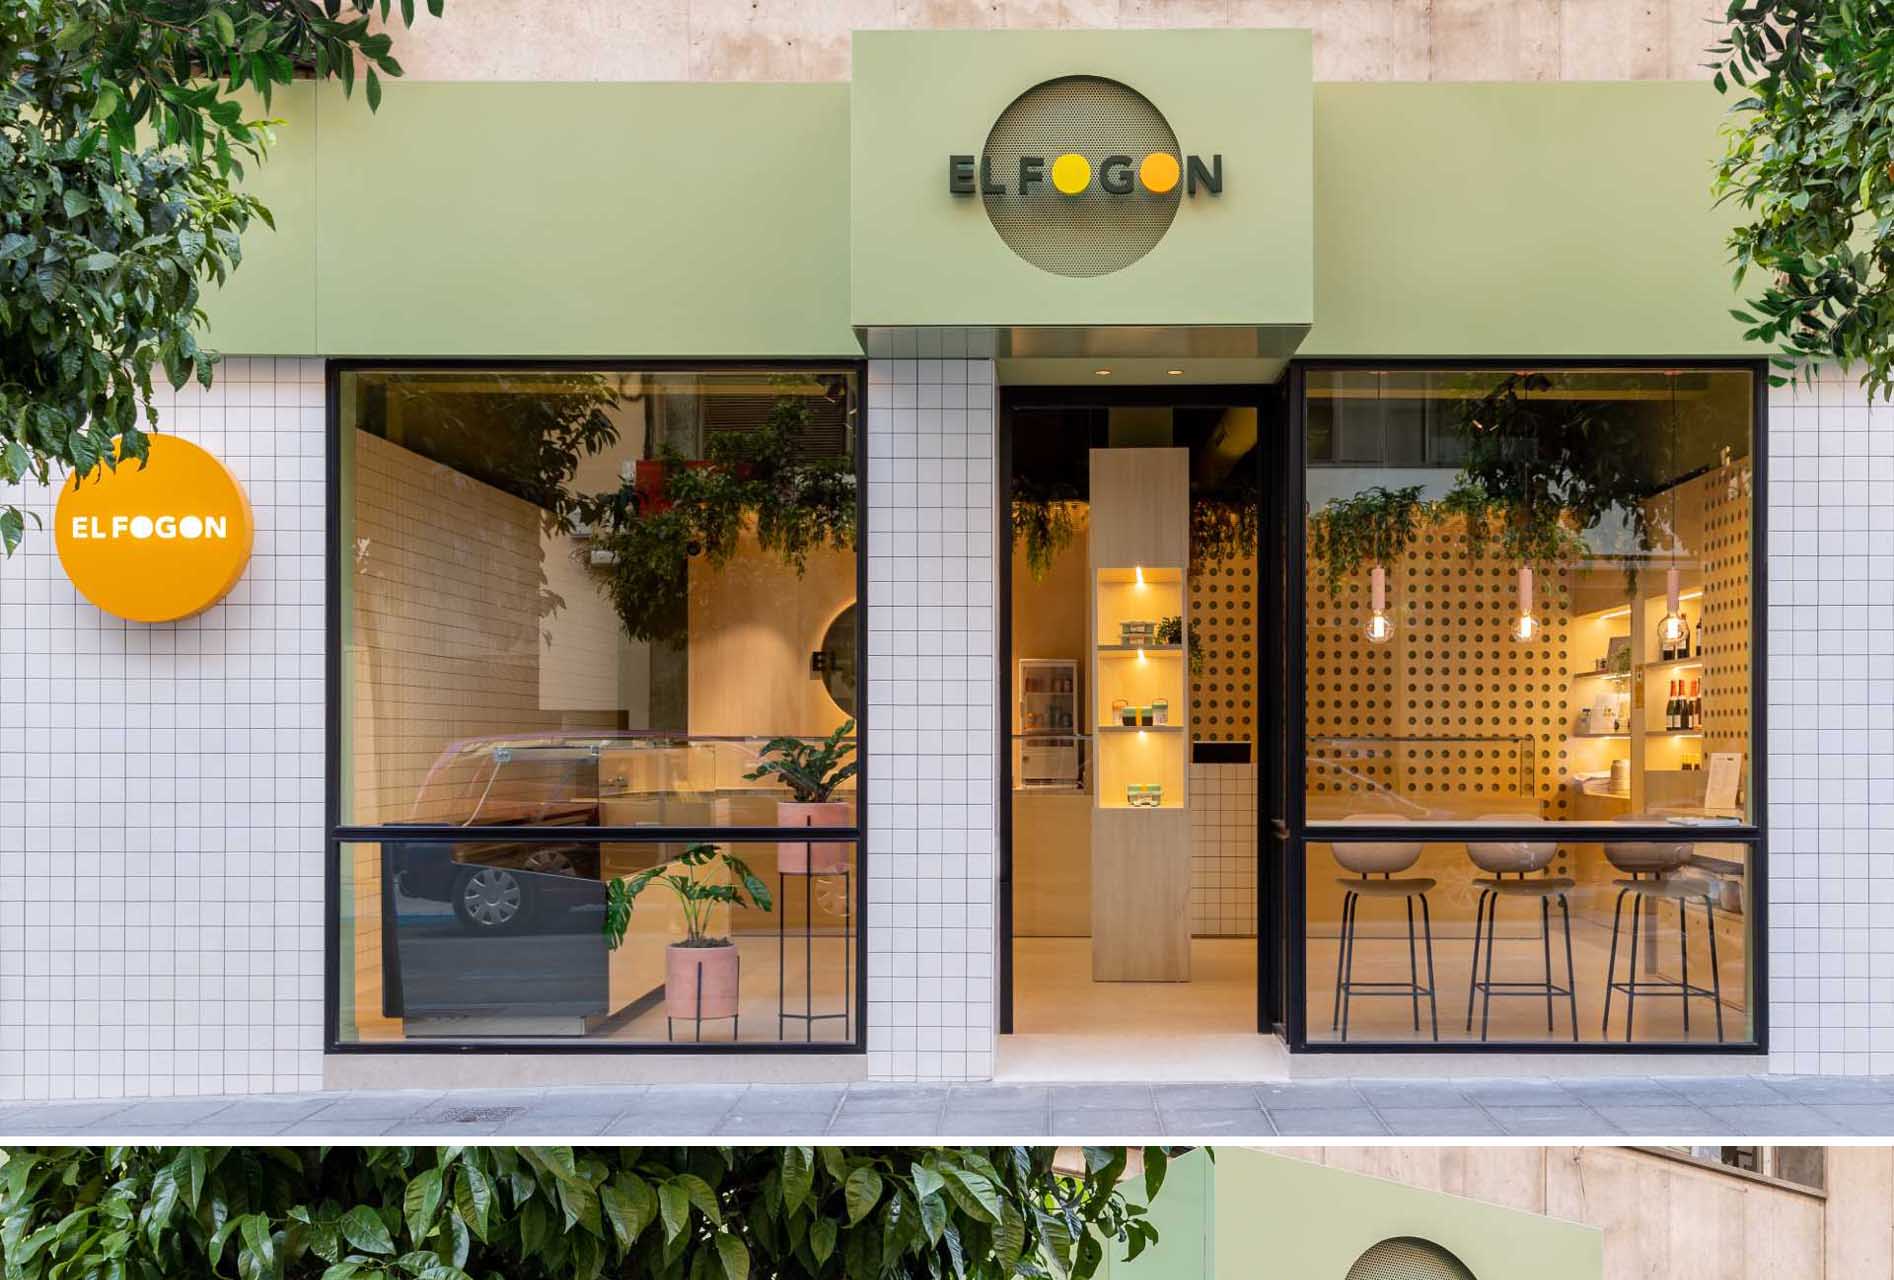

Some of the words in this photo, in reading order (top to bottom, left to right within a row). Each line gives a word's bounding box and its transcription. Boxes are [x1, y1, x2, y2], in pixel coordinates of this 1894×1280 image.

[949, 154, 1006, 195] EL
[1019, 152, 1222, 195] FOGON
[72, 516, 107, 539] EL
[112, 515, 228, 539] FOGON
